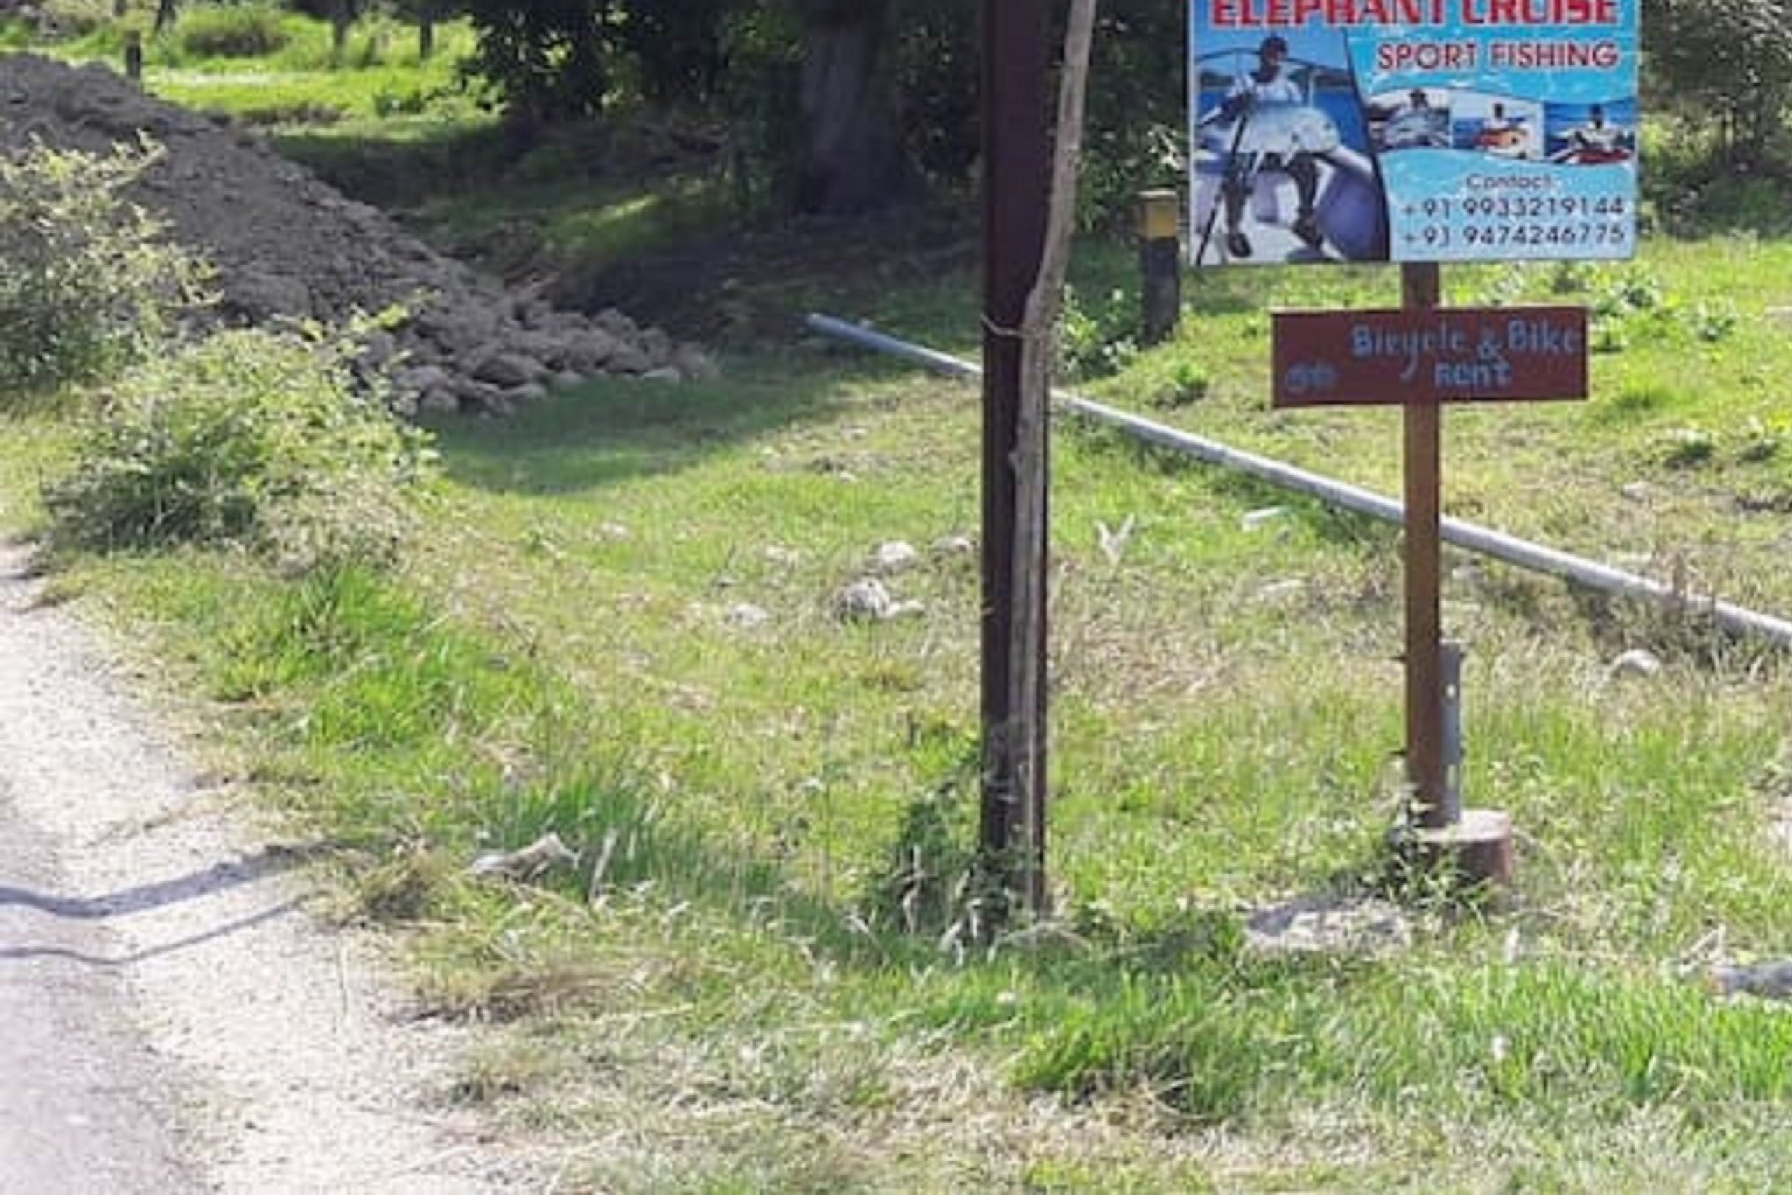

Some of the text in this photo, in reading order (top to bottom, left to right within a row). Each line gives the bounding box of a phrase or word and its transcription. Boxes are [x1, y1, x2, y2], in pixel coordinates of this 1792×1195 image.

[1377, 42, 1618, 70] SPORT FISHING
[1463, 196, 1624, 217] 9933219144
[1351, 320, 1465, 382] Bicycle
[1507, 318, 1580, 354] Bike
